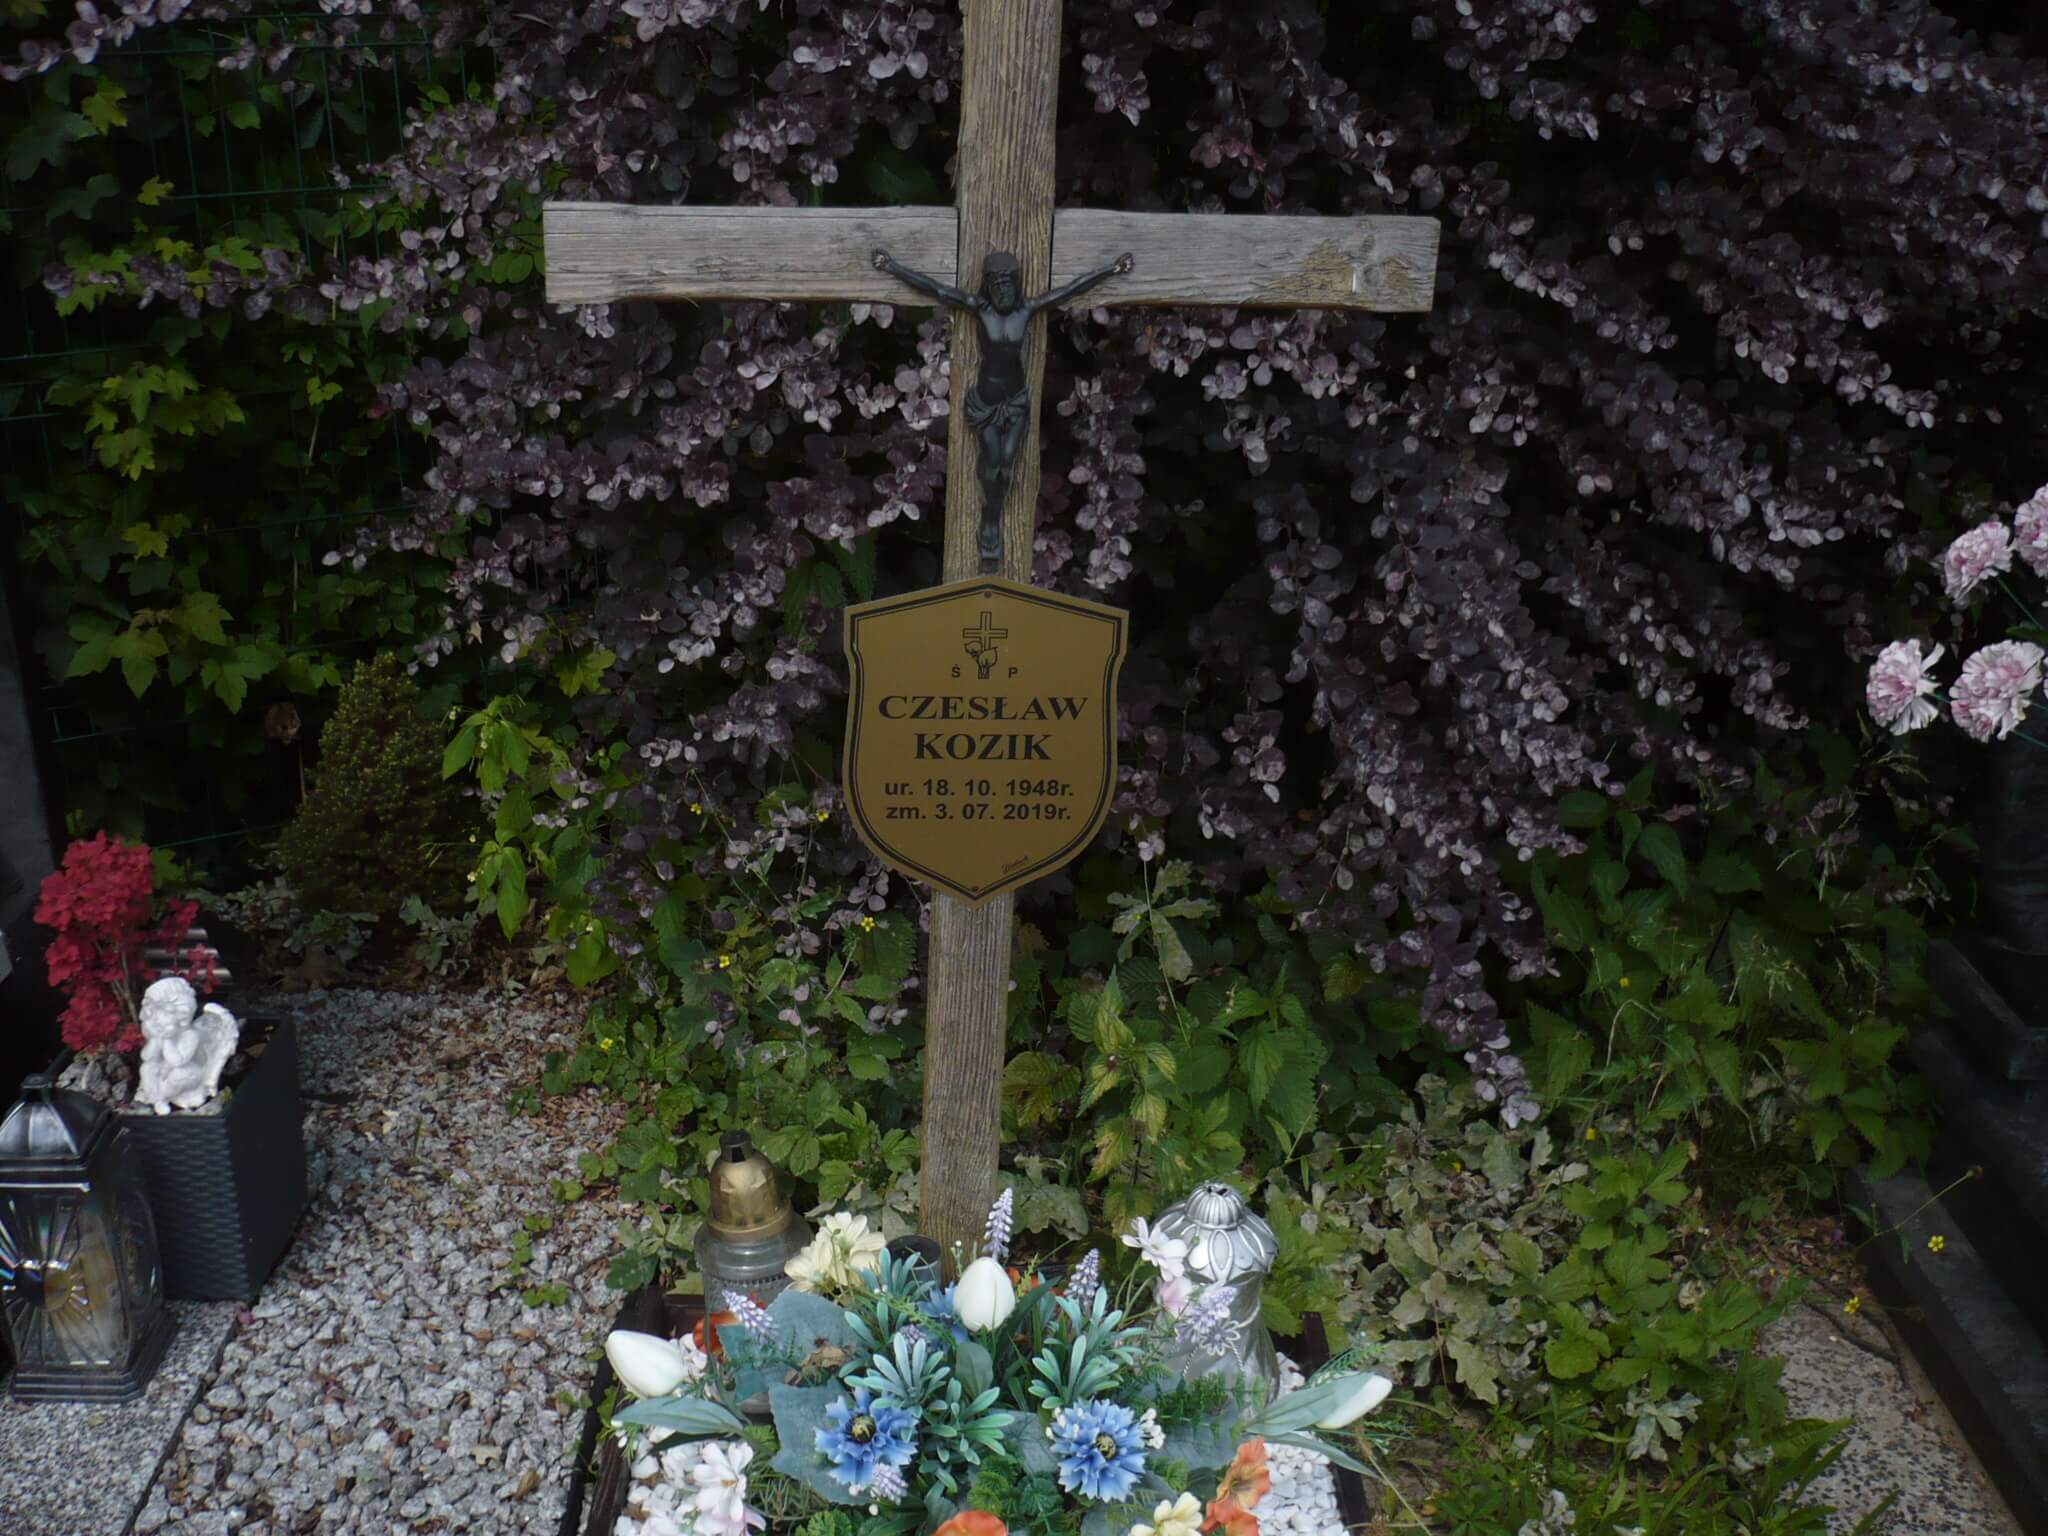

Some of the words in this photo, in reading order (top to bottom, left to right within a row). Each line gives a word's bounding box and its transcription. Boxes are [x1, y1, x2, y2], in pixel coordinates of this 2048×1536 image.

[1008, 667, 1018, 679] P
[878, 695, 1089, 720] CZESŁAW
[914, 733, 1053, 760] KOZIK
[884, 783, 914, 797] ur.
[923, 779, 955, 797] 18.
[965, 779, 997, 797] 10.
[1006, 779, 1075, 797] 1948r.
[885, 806, 927, 820] zm.
[935, 803, 954, 820] 3.
[962, 803, 995, 820] 07.
[1003, 803, 1072, 820] 2019r.
